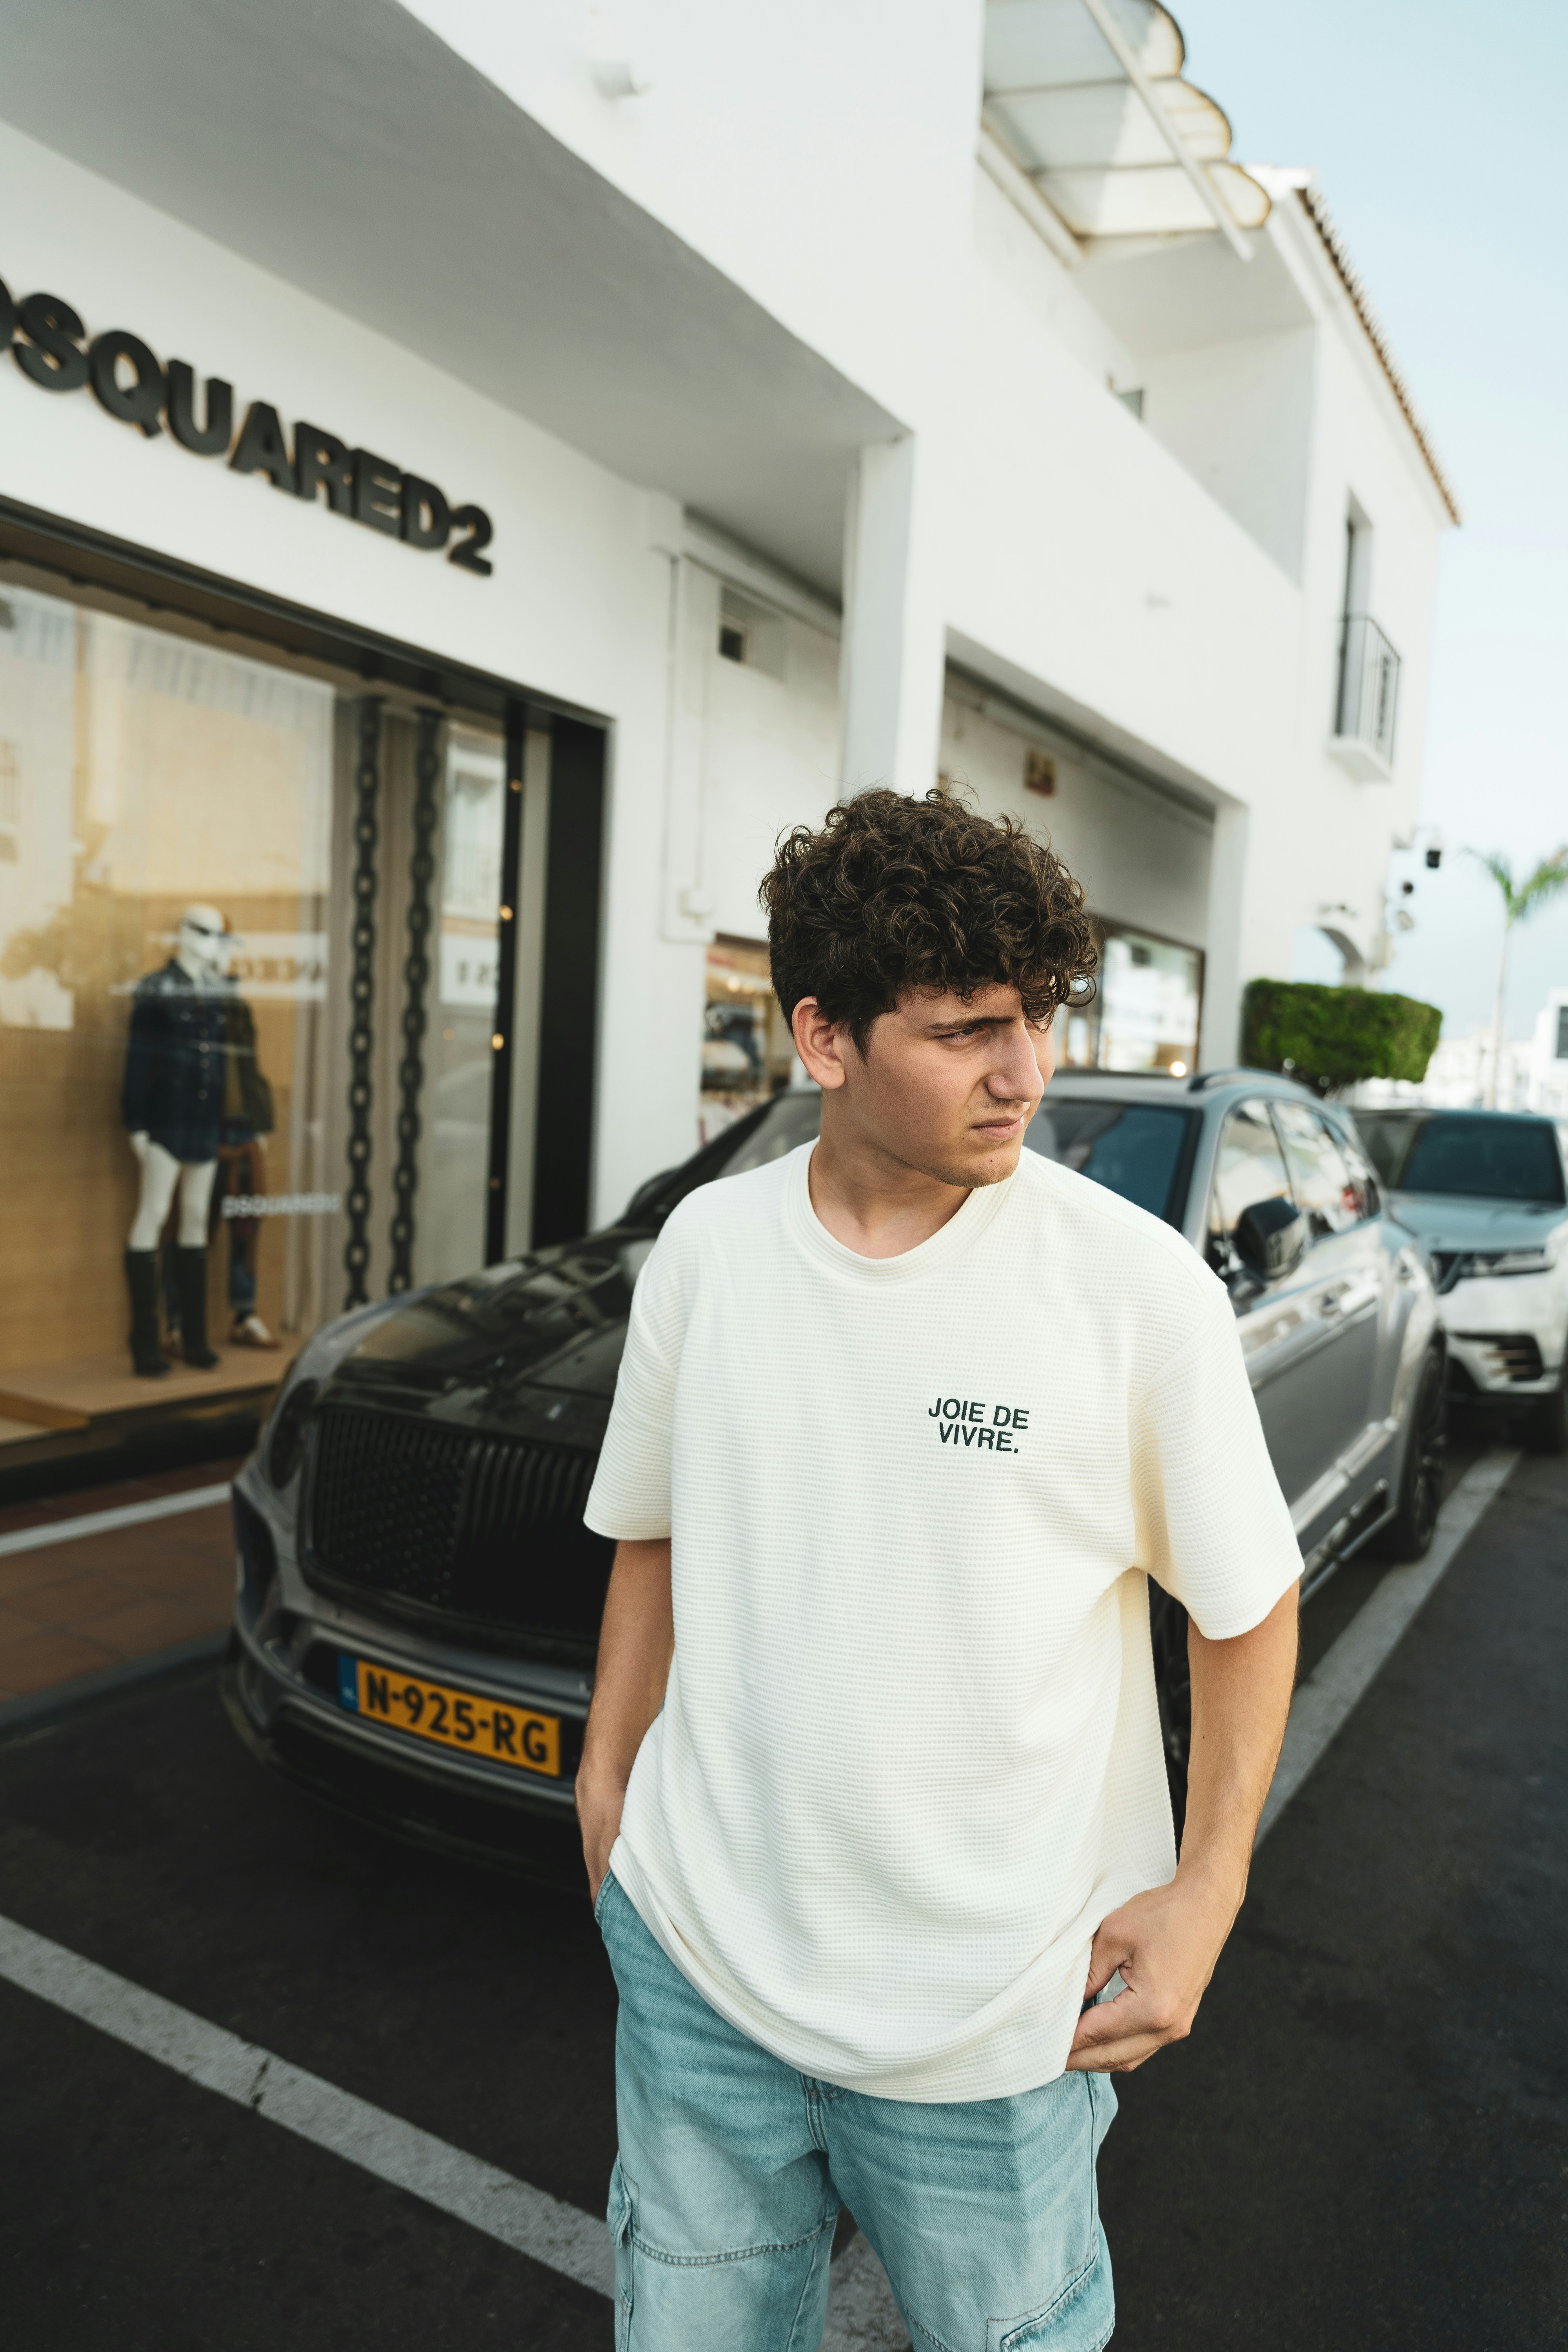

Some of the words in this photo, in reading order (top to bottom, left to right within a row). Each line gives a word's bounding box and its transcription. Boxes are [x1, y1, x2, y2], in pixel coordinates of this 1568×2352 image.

[0, 277, 494, 577] SQUARED2
[928, 1398, 985, 1423] JOIE
[993, 1405, 1029, 1430] DE
[939, 1422, 1018, 1454] VIVRE.
[366, 1671, 547, 1763] N-925-RG
